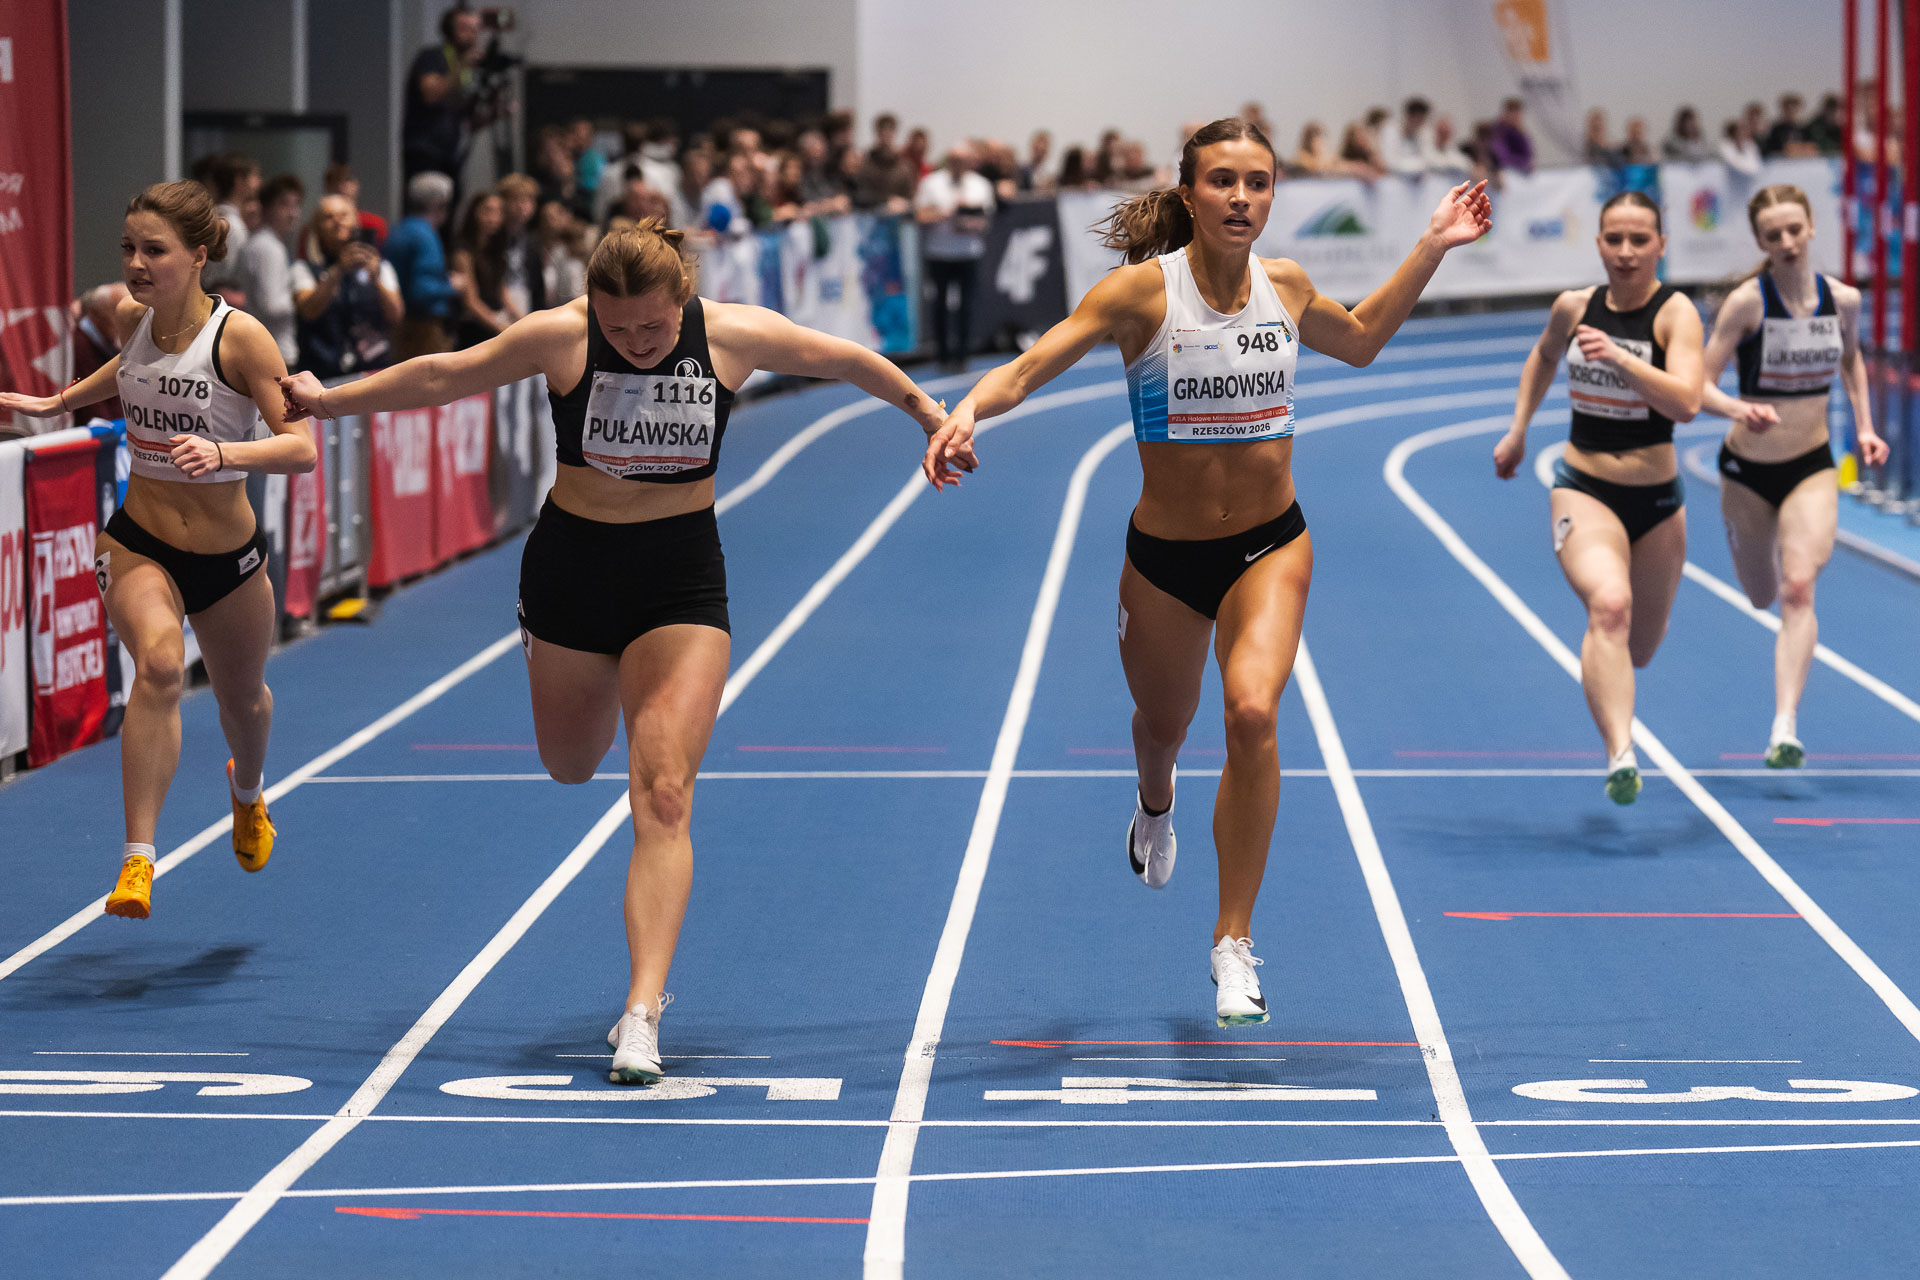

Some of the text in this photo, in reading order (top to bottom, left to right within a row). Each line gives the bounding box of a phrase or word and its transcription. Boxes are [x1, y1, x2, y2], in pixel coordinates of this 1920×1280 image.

[996, 227, 1052, 302] 4F
[1236, 331, 1279, 355] 948
[158, 375, 209, 399] 1078
[653, 382, 713, 405] 1116
[1173, 370, 1285, 400] GRABOWSKA
[122, 400, 210, 433] MOLENDA
[1212, 414, 1249, 422] Mistrzostwa
[588, 417, 709, 446] PUŁAWSKA
[1192, 422, 1271, 436] RZESZÓW 2026
[134, 448, 169, 464] RZESZÓW
[0, 1070, 1918, 1104] 6 5 4 3
